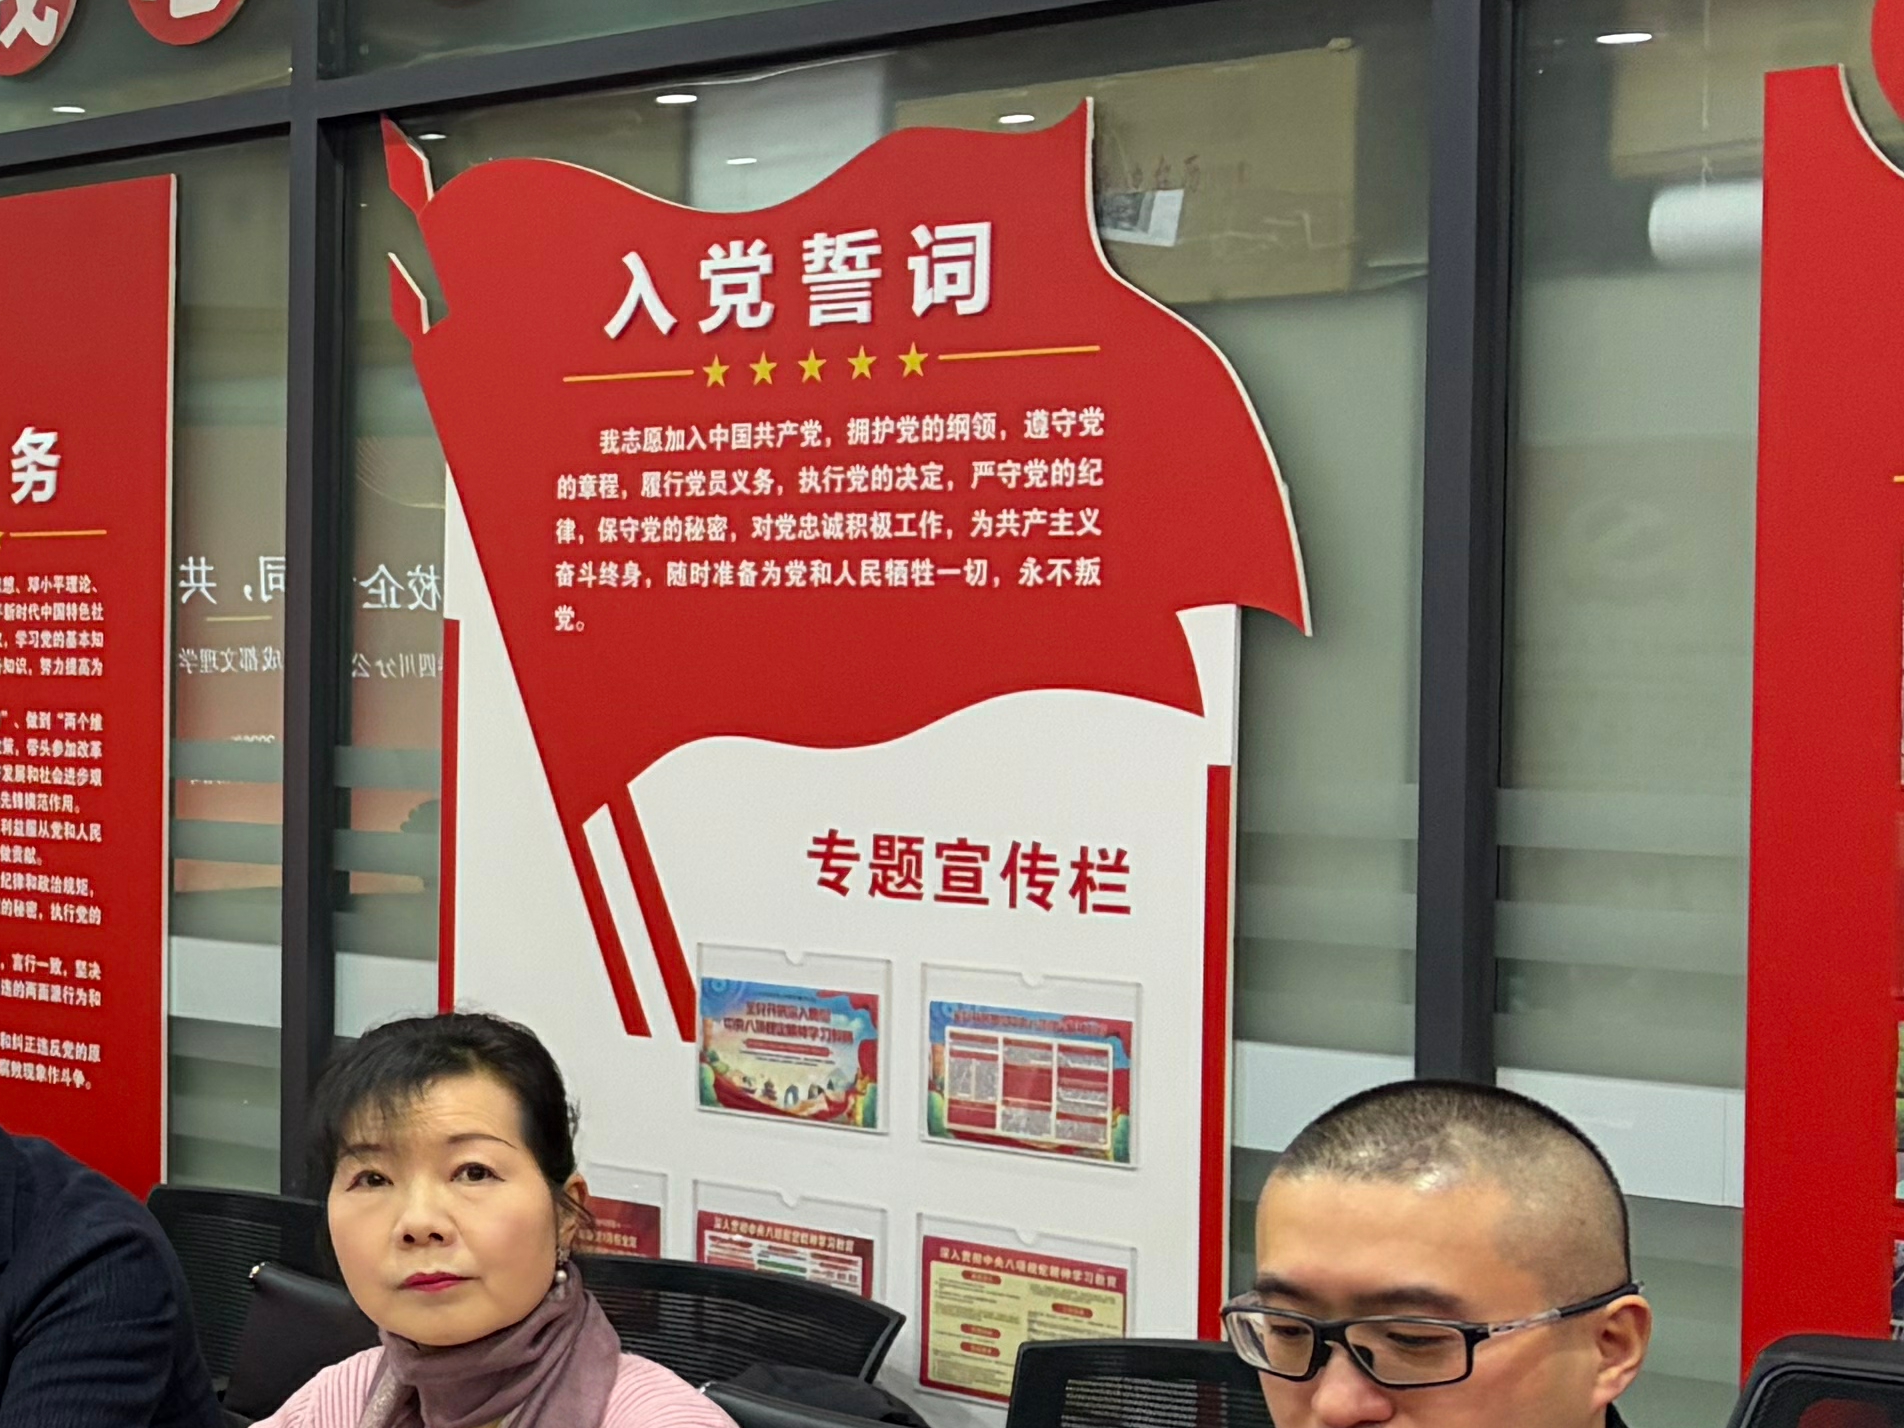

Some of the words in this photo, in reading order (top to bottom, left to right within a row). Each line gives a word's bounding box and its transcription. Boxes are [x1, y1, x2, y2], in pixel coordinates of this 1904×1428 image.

[603, 221, 992, 340] 入党誓词
[555, 605, 588, 634] 党。
[807, 828, 1132, 915] 专题宣传栏
